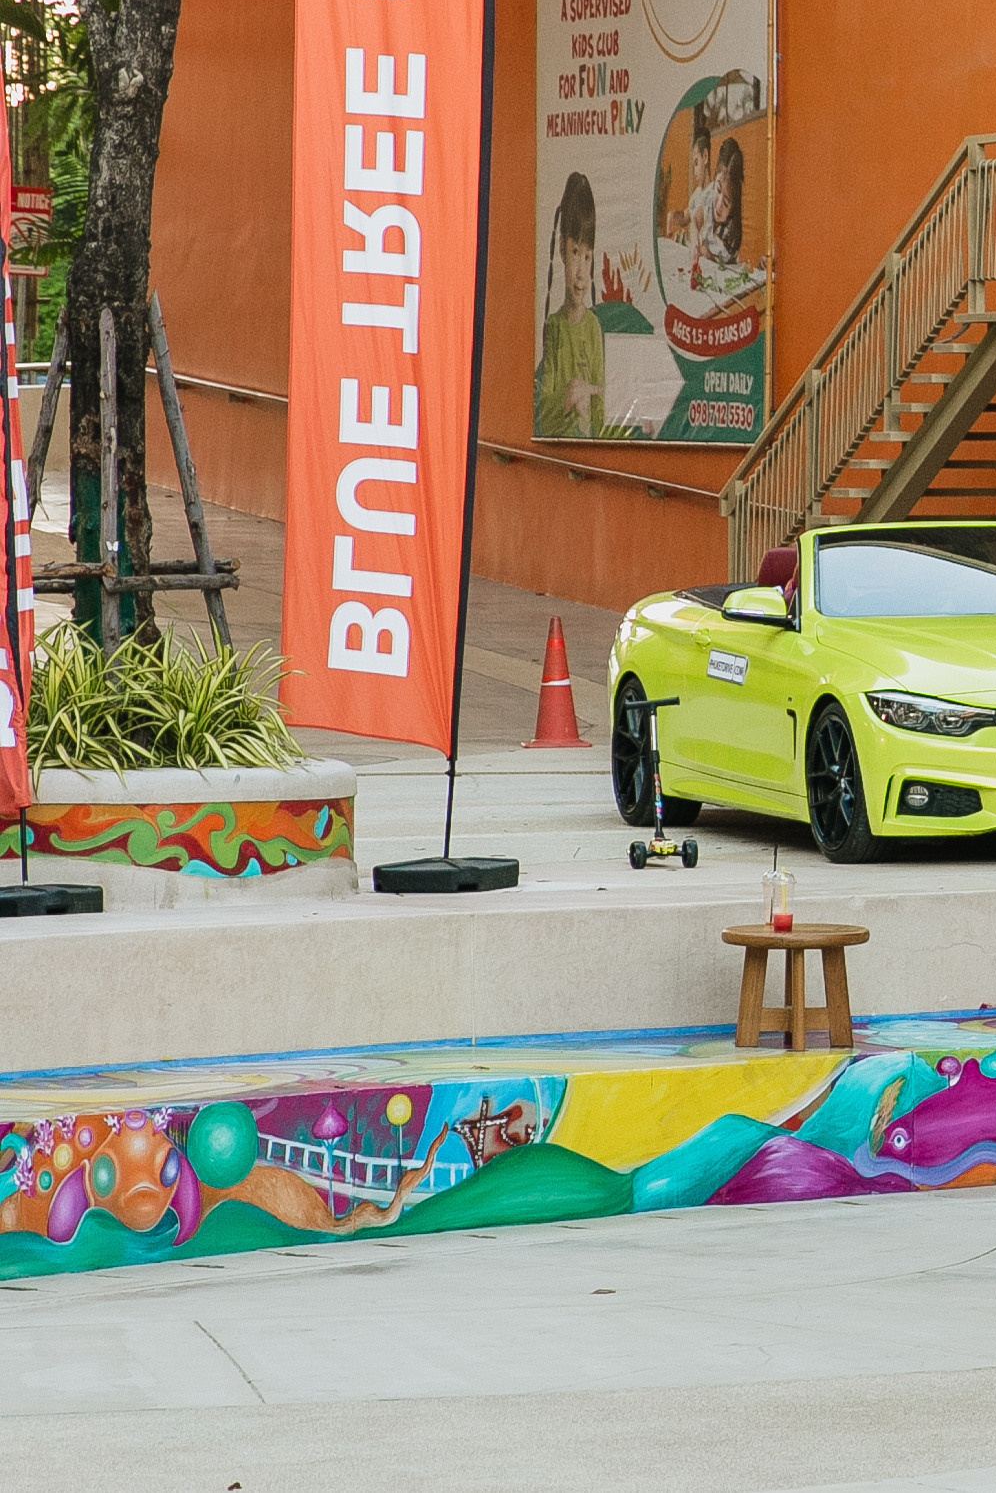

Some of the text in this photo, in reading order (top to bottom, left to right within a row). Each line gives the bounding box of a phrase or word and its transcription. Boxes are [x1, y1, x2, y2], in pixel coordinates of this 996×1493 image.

[597, 29, 619, 57] CLUB
[559, 62, 629, 99] FOR FUN AND
[611, 98, 645, 136] PLAY
[673, 319, 691, 344] AGES
[708, 329, 714, 345] 6
[715, 323, 739, 345] YEARS
[739, 317, 752, 339] OLD
[704, 371, 727, 393] OPEN
[690, 401, 754, 430] 098 712 5530
